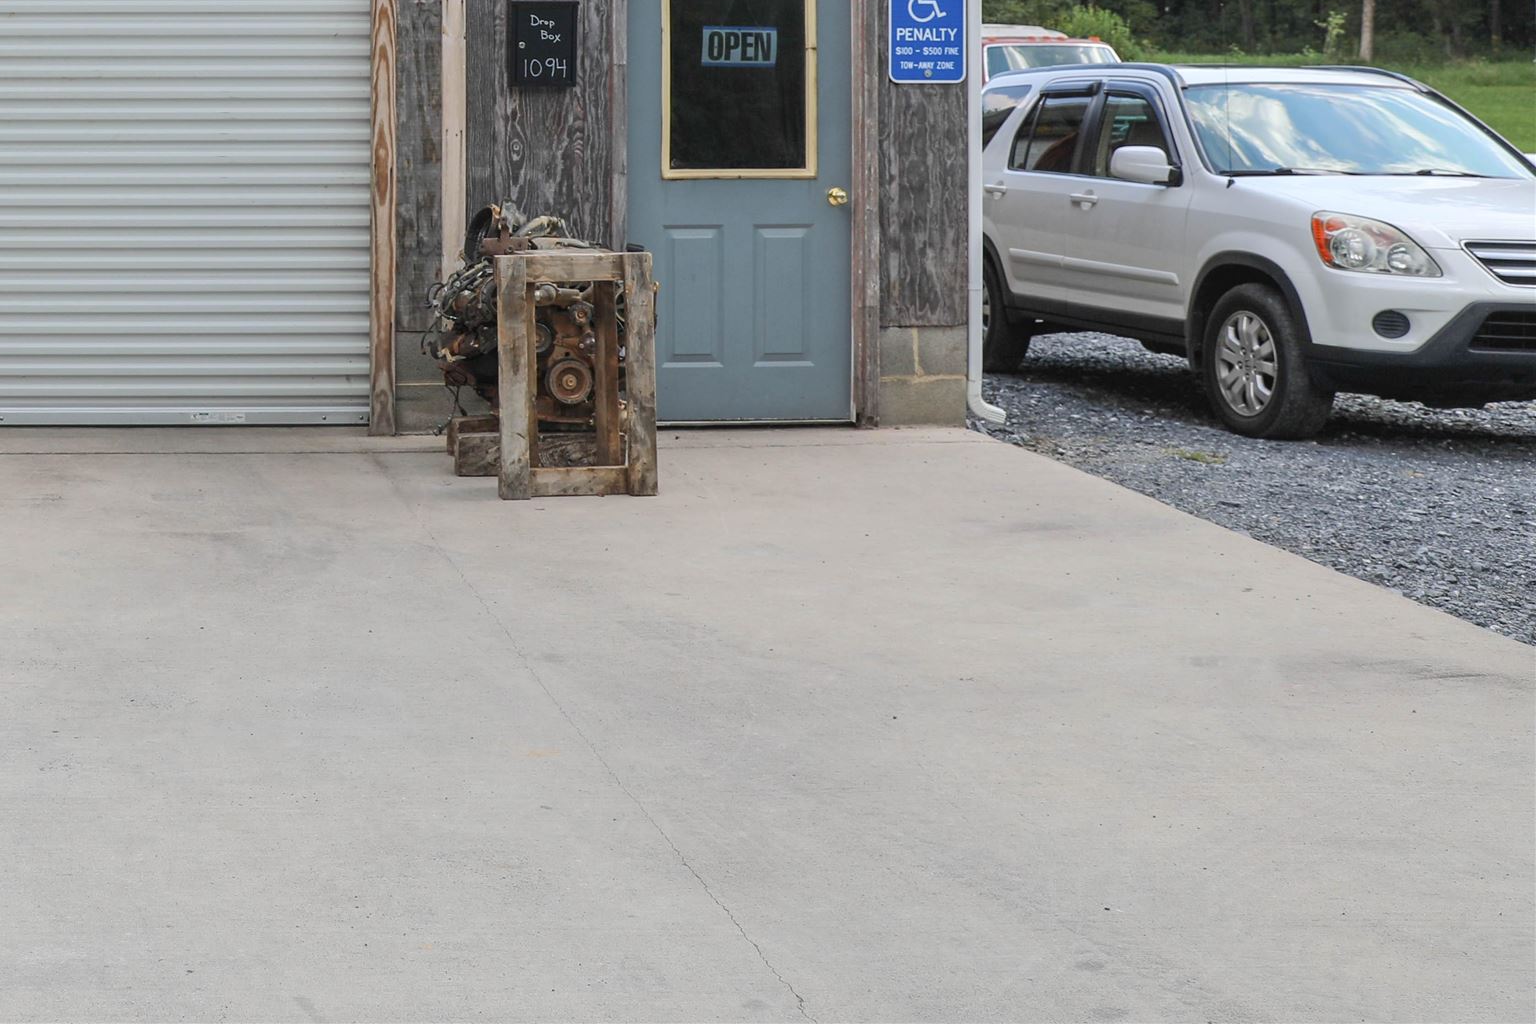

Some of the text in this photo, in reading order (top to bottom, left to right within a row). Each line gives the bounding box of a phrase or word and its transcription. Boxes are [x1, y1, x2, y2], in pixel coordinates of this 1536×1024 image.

[530, 15, 555, 28] Drop
[541, 30, 561, 43] Box
[897, 28, 957, 41] PENALTY
[707, 32, 771, 62] OPEN
[945, 47, 959, 55] FINE
[524, 58, 567, 78] 1094
[901, 61, 934, 69] TOW-AWAY
